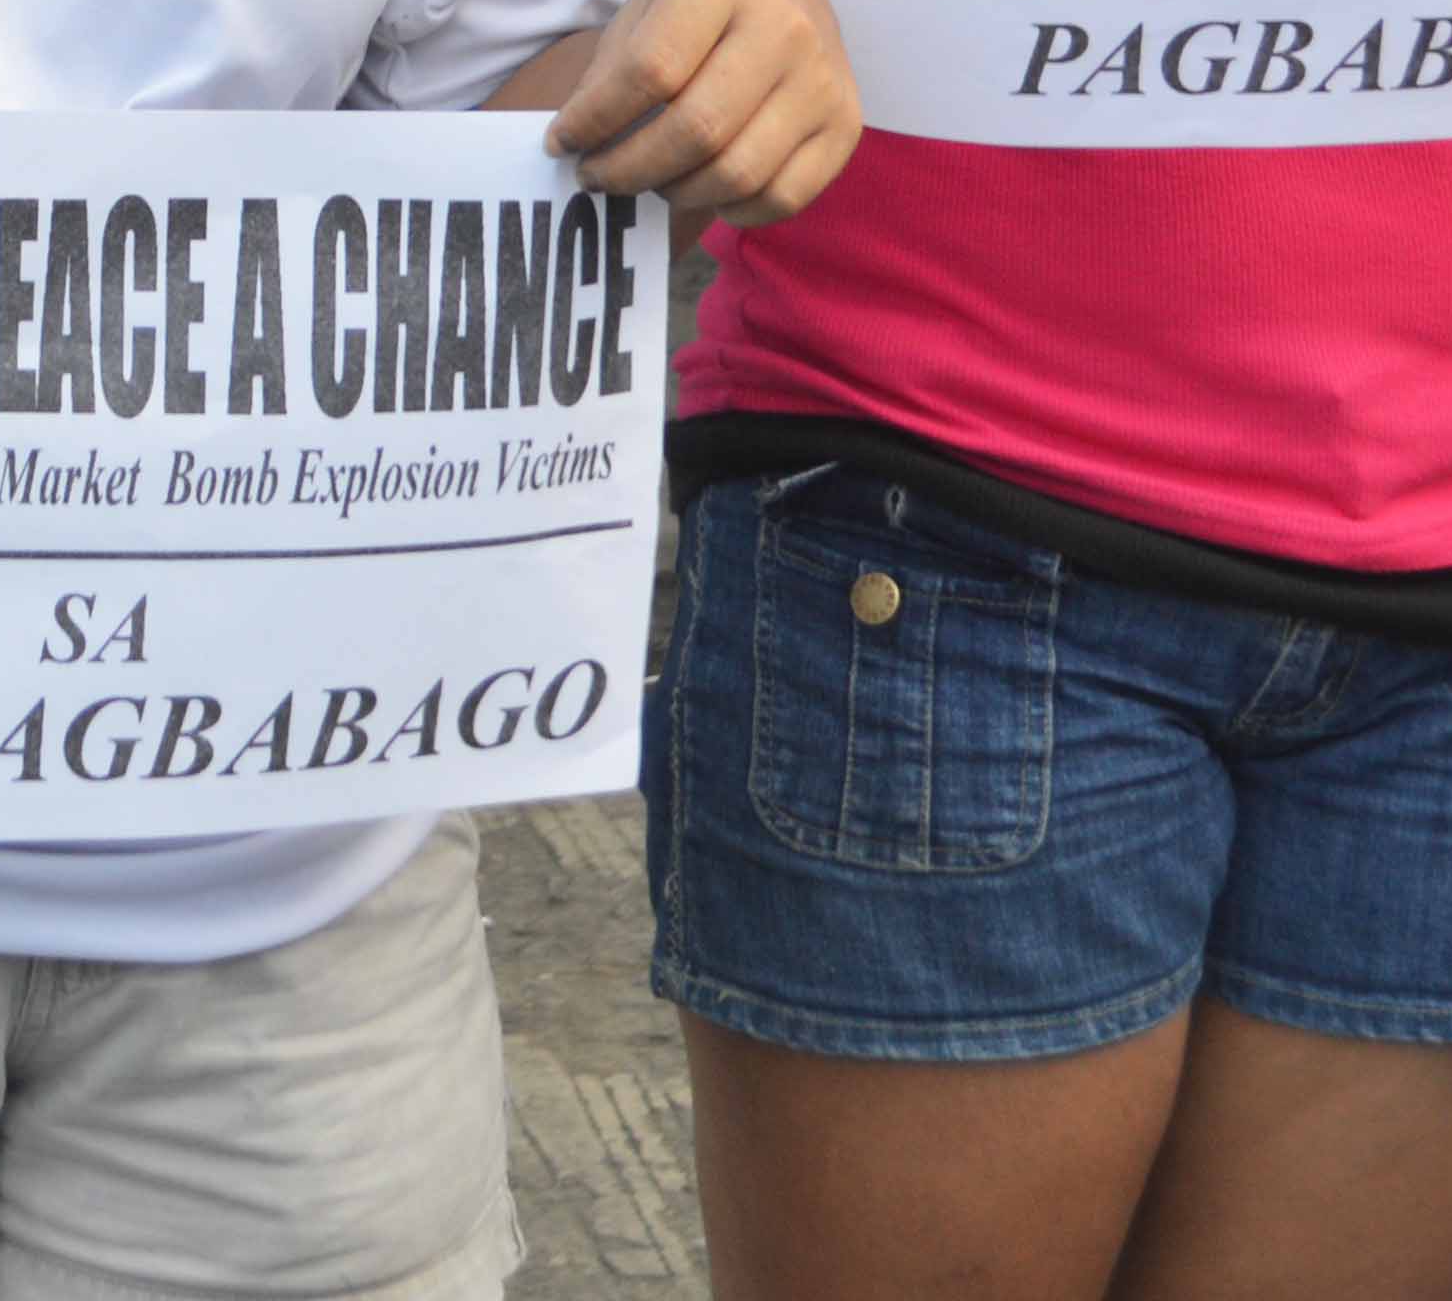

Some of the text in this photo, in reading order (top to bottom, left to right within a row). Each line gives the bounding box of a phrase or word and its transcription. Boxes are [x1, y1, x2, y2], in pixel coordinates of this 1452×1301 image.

[228, 196, 288, 416] A
[309, 190, 638, 418] CHANCE
[164, 444, 280, 507] Bomb
[288, 449, 482, 522] Explosion
[492, 438, 616, 506] Victims
[37, 590, 151, 663] SA
